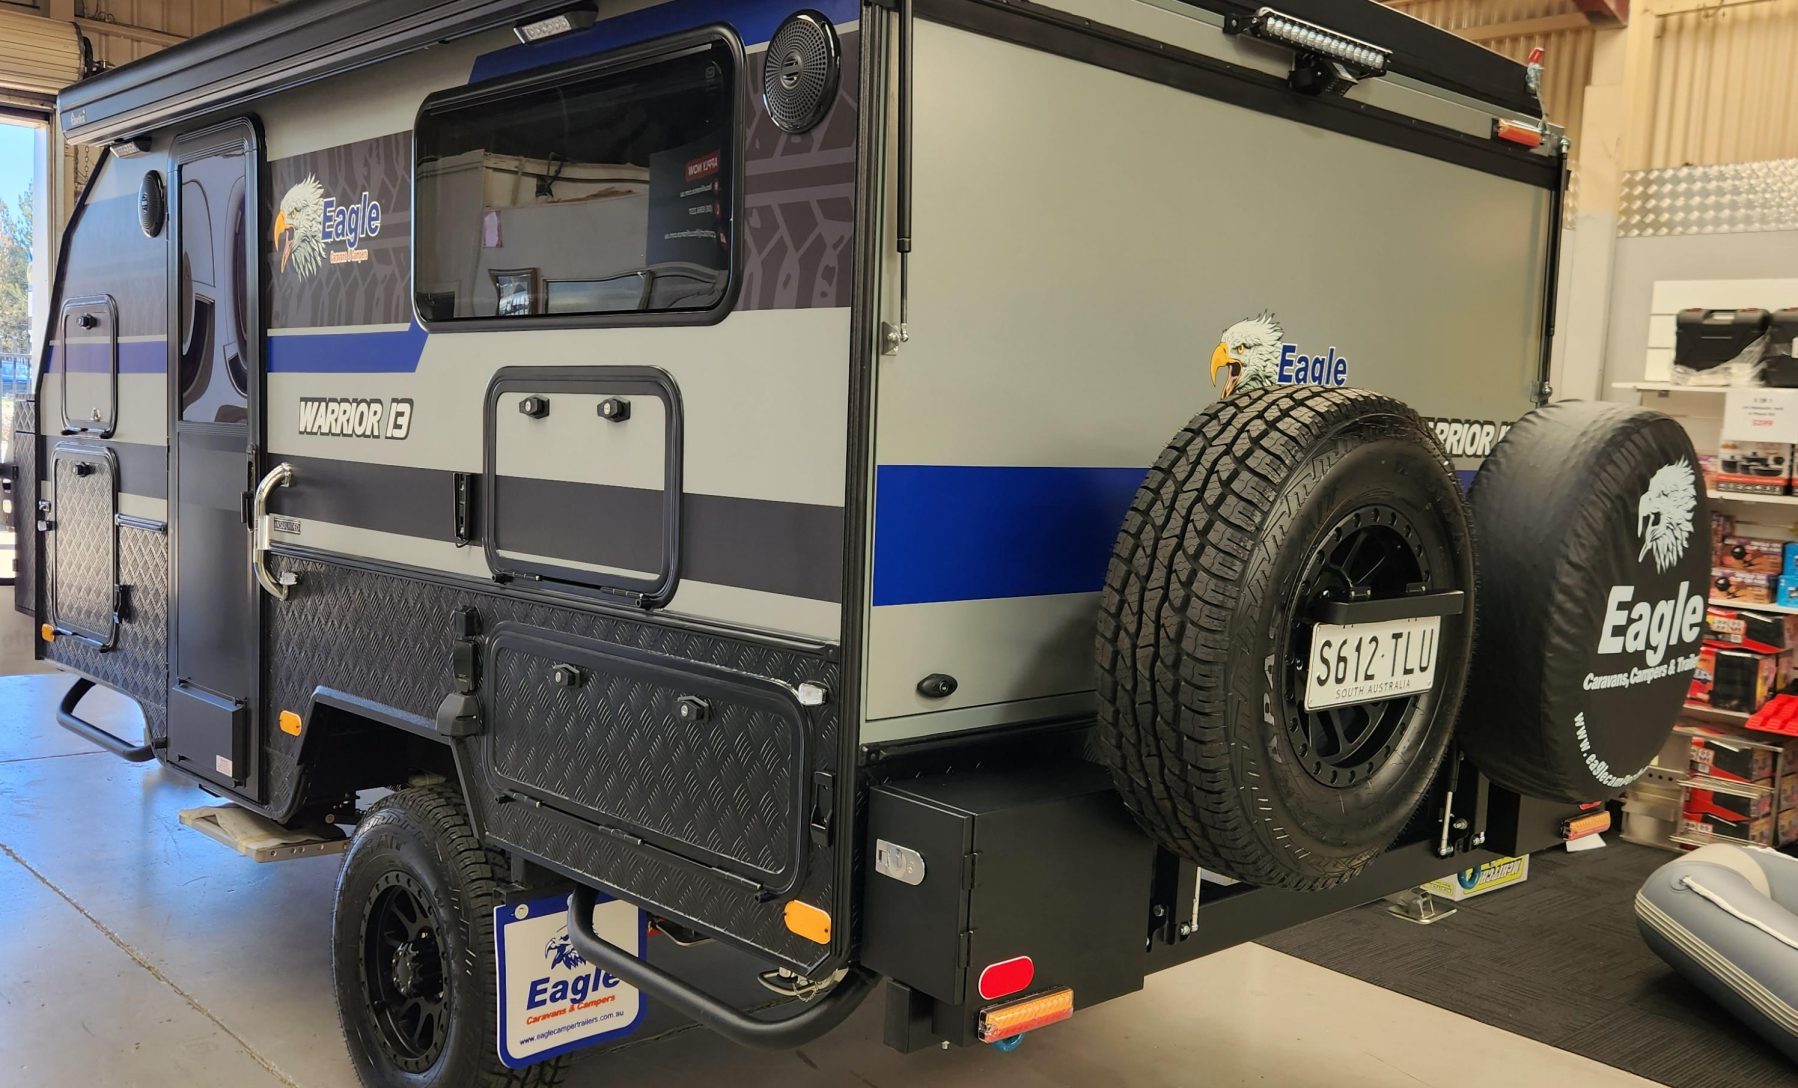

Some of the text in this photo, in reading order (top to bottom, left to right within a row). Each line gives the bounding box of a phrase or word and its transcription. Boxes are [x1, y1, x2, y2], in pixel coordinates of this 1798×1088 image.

[321, 191, 381, 249] Eagle
[299, 397, 414, 440] WARRIOR 13
[1597, 581, 1704, 667] Eagle
[1335, 679, 1411, 699] SOUTH AUSTRALIA
[1630, 667, 1668, 684] Campers
[526, 967, 620, 1010] Eagle
[520, 1010, 624, 1045] www.eaglecampertrailers.com.au
[526, 994, 616, 1025] Caravans & Campers
